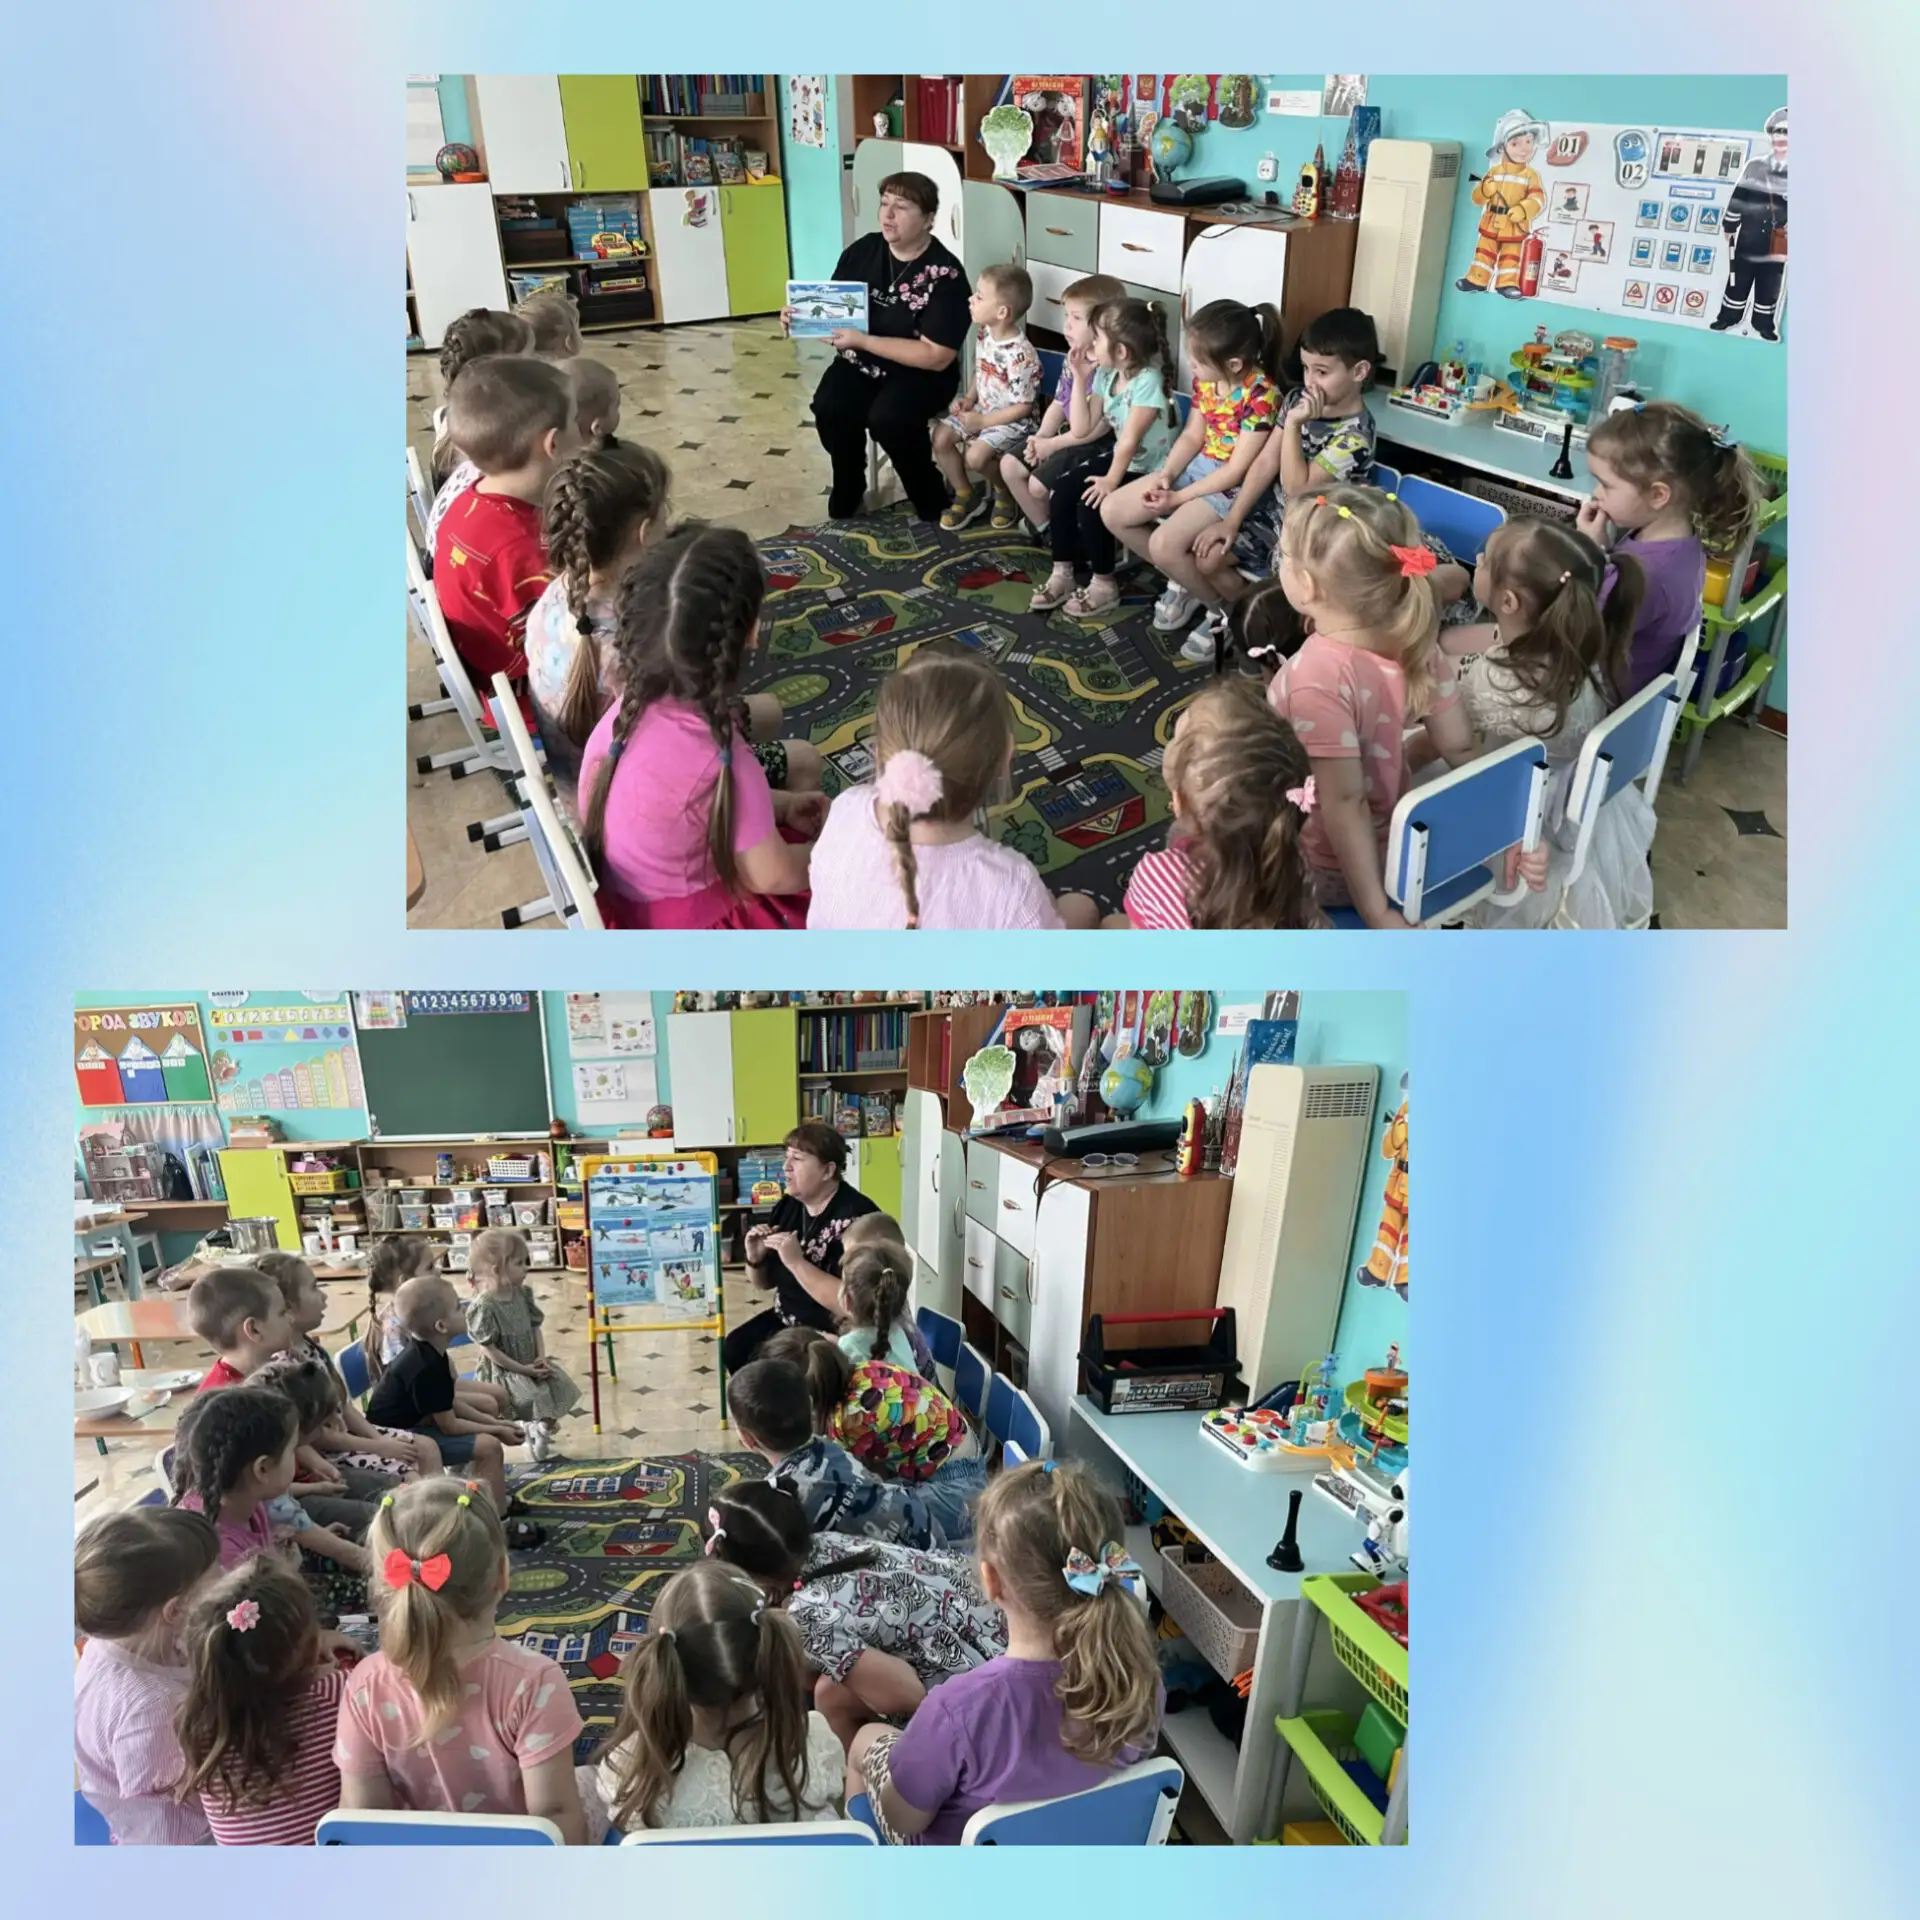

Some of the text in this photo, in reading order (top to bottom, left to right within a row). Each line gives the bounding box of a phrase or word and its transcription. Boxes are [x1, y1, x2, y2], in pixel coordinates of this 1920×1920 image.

[1558, 136, 1579, 154] 01
[1622, 163, 1644, 181] 02
[412, 993, 522, 1008] 0 1 2 3 4 5 6 7 8 9 10
[74, 1013, 127, 1032] ОРОД
